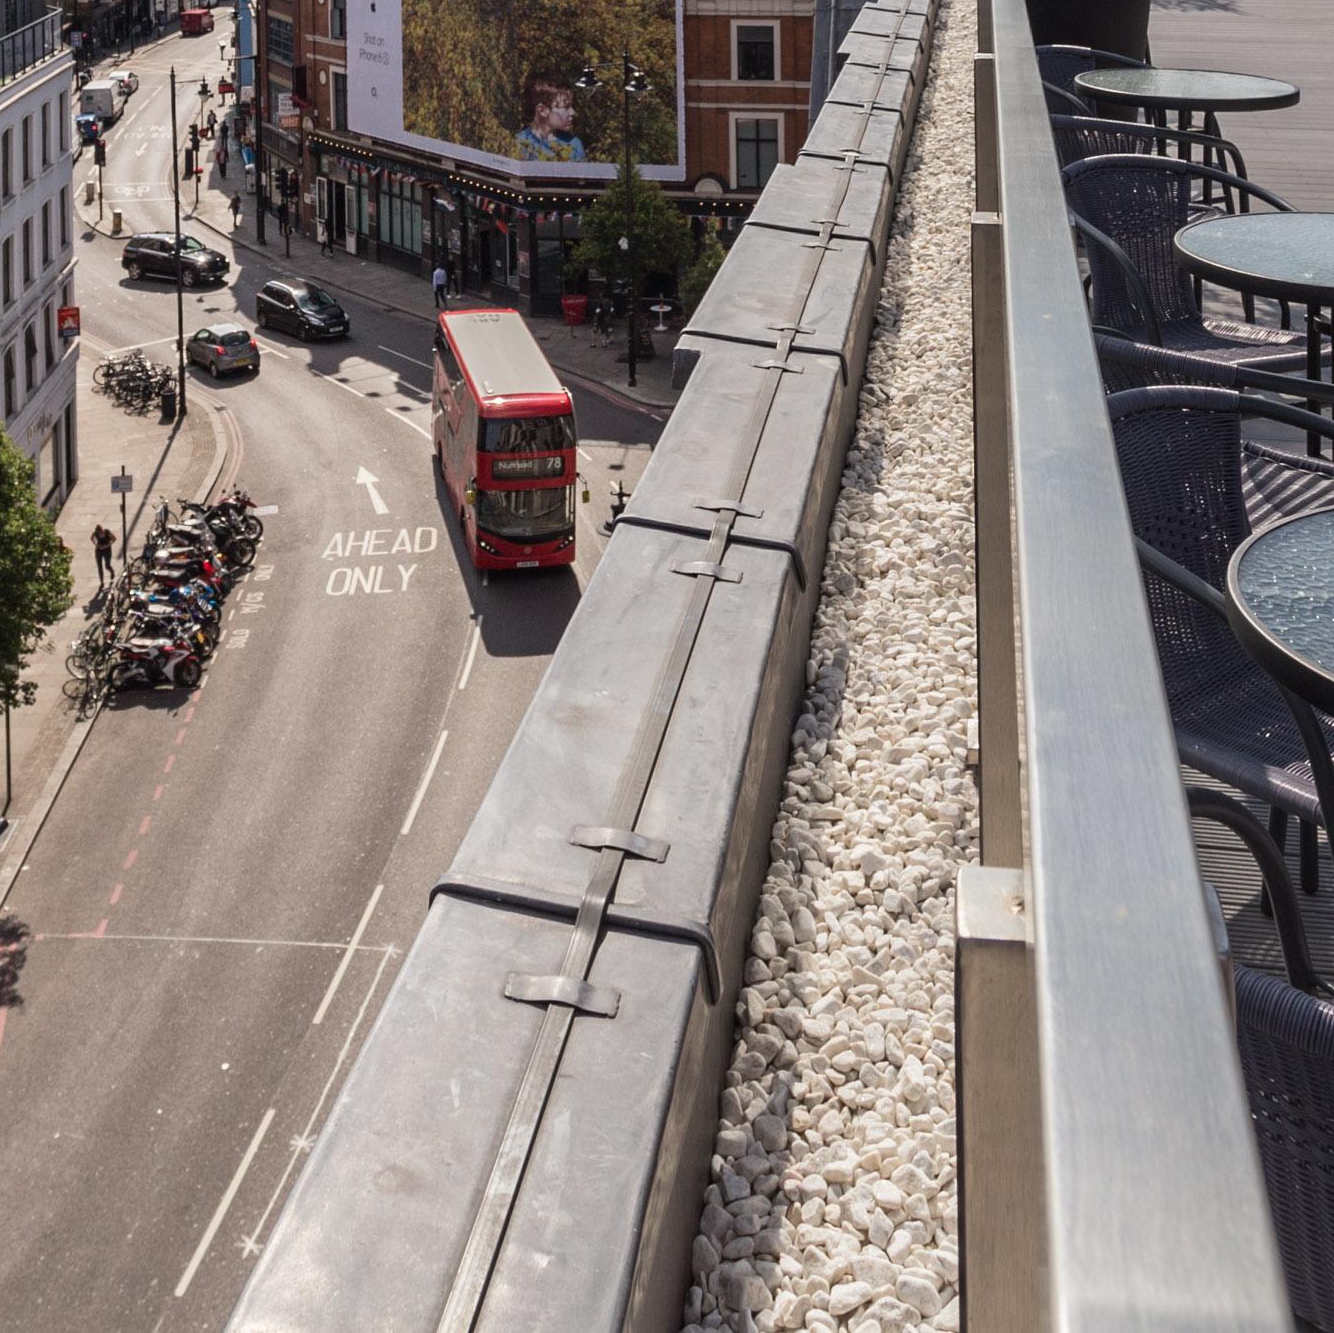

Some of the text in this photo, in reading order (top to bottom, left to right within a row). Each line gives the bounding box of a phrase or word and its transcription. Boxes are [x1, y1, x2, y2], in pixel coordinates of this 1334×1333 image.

[547, 457, 562, 469] 78
[321, 527, 438, 558] AHEAD
[326, 564, 418, 596] ONLY
[225, 629, 250, 649] SOLO
